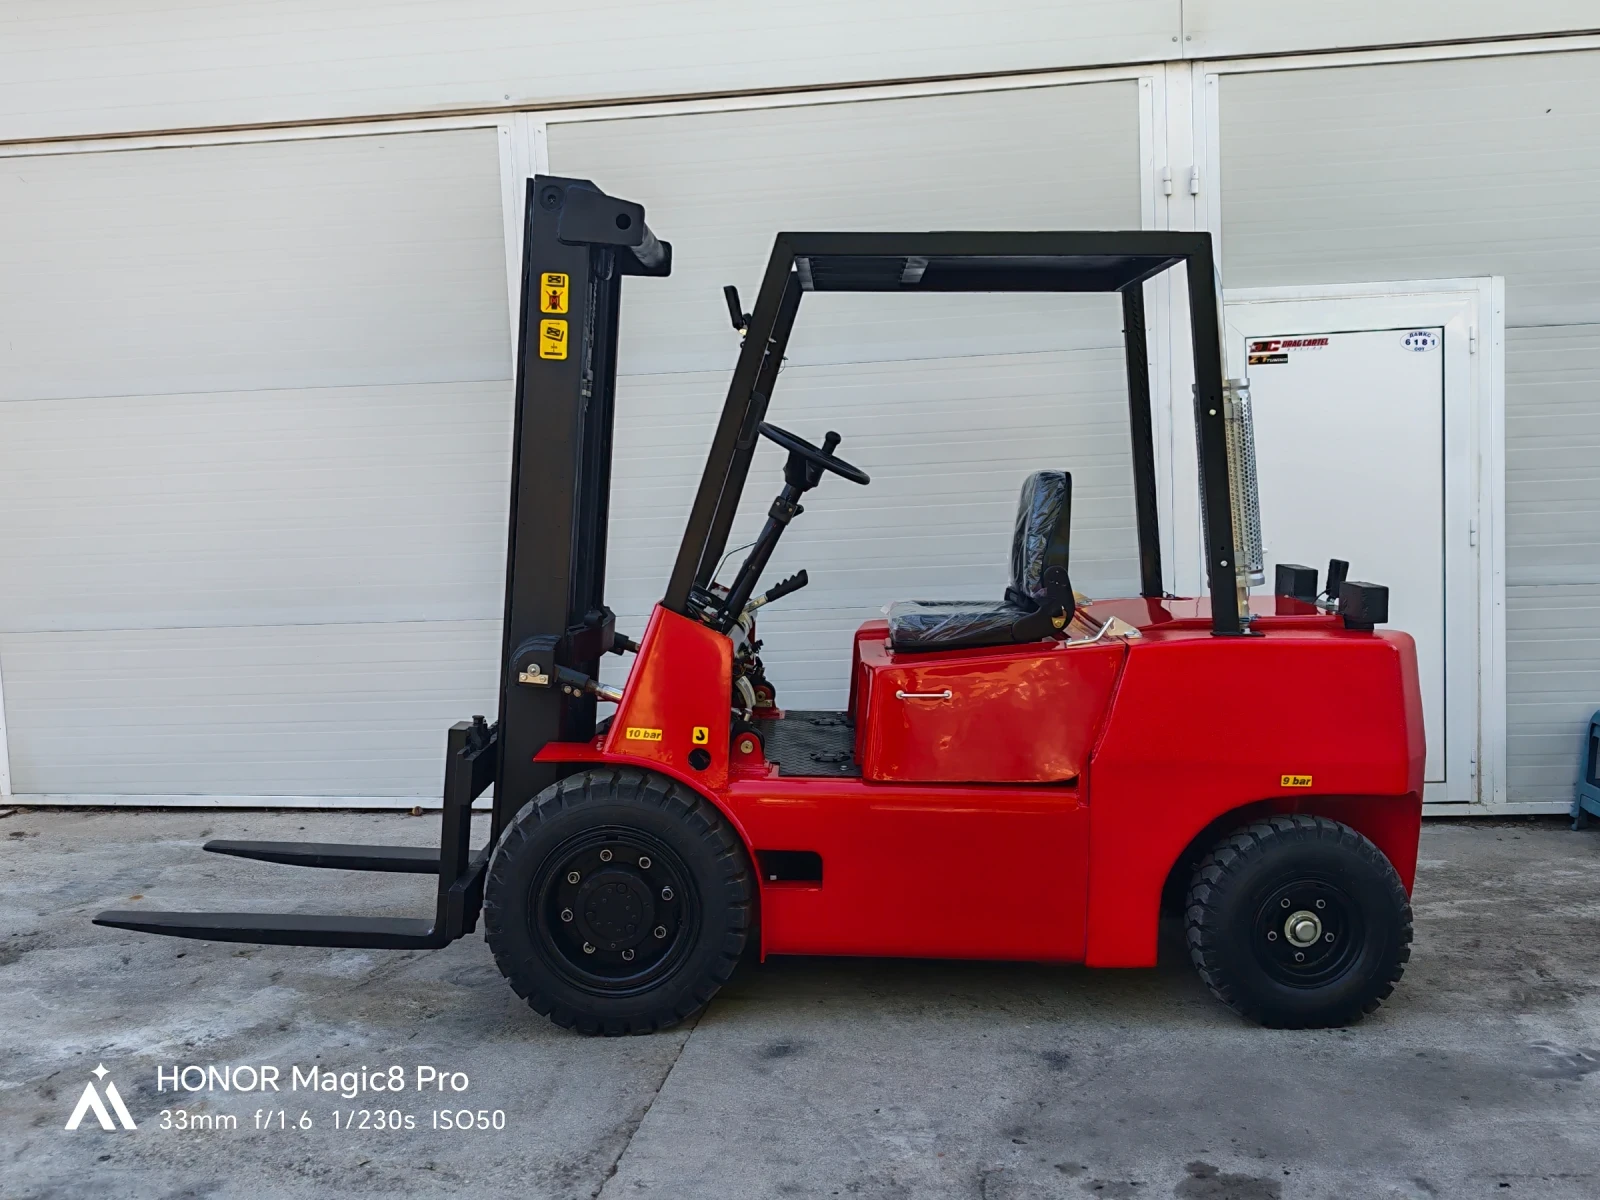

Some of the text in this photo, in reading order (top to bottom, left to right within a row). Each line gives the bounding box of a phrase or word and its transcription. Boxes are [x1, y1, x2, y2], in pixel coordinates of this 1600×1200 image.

[1281, 340, 1302, 348] DRAG
[1302, 338, 1329, 347] CARTEL
[628, 730, 662, 740] 10 bar
[1283, 776, 1311, 785] 9 bar
